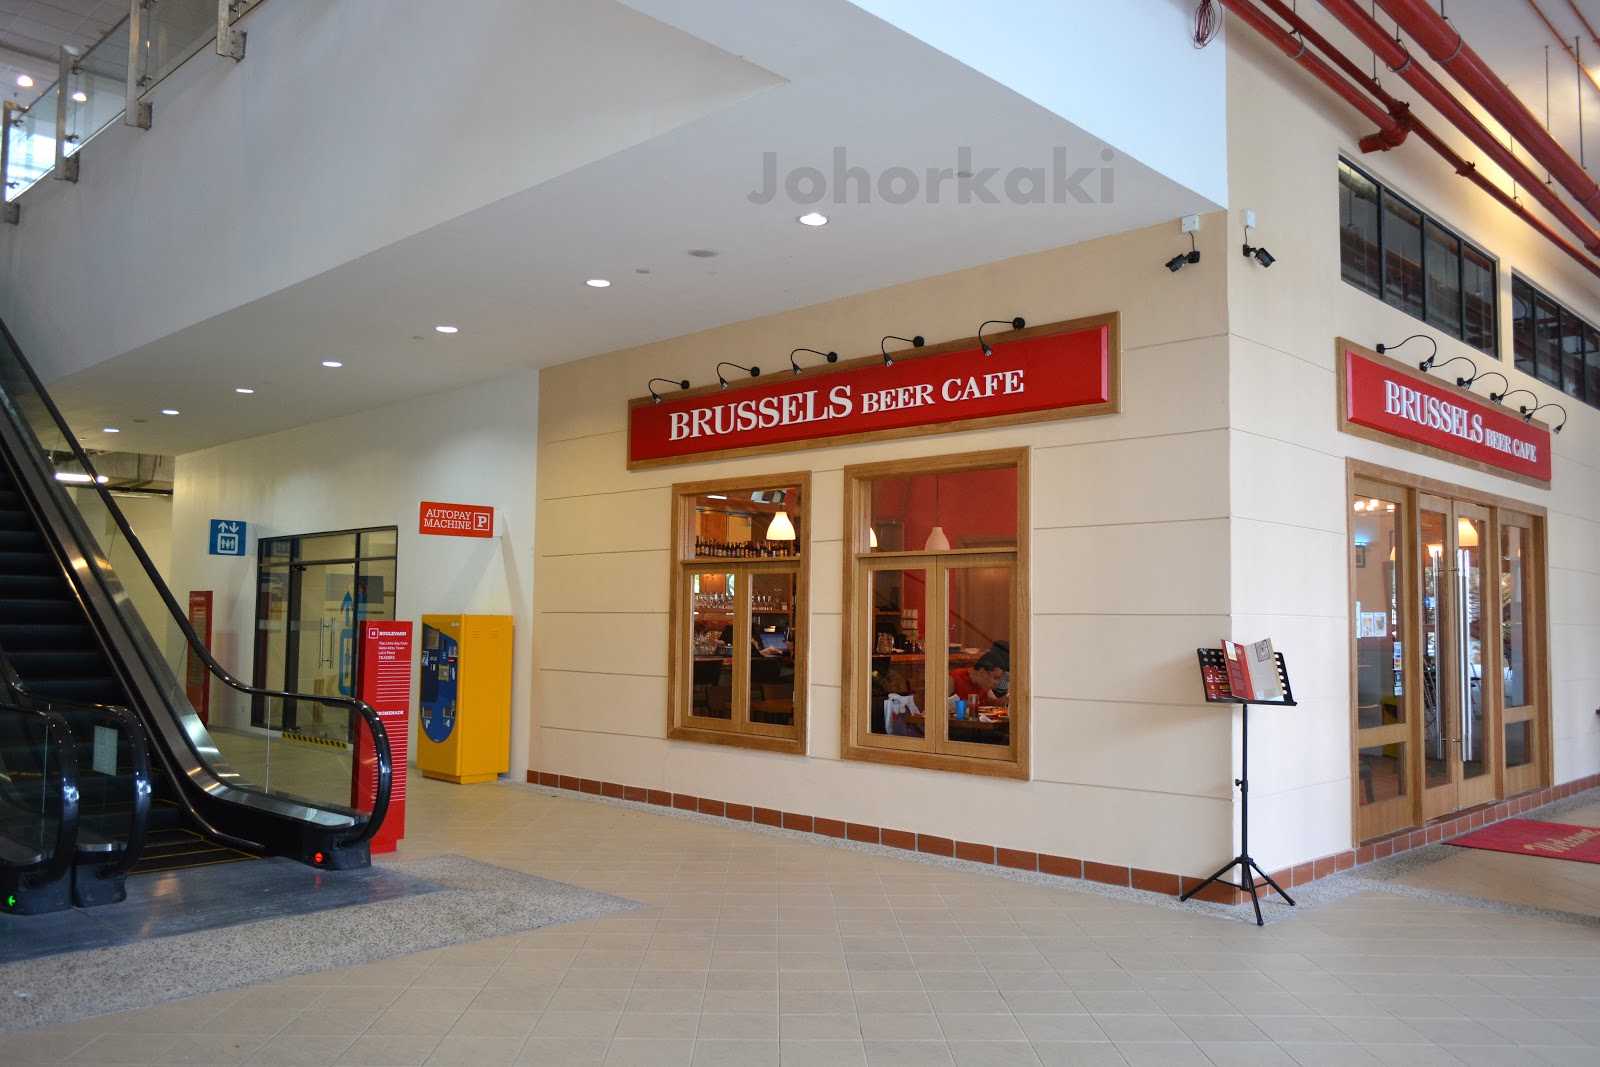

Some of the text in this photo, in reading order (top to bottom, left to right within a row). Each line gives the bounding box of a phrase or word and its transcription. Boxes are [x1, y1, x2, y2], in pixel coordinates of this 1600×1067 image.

[669, 369, 1025, 441] BRUSSELS BEER CAFE
[1384, 379, 1538, 463] BRUSSELS BEER CAFE
[423, 515, 487, 530] MACHINE P
[425, 508, 472, 520] AUTOPAY
